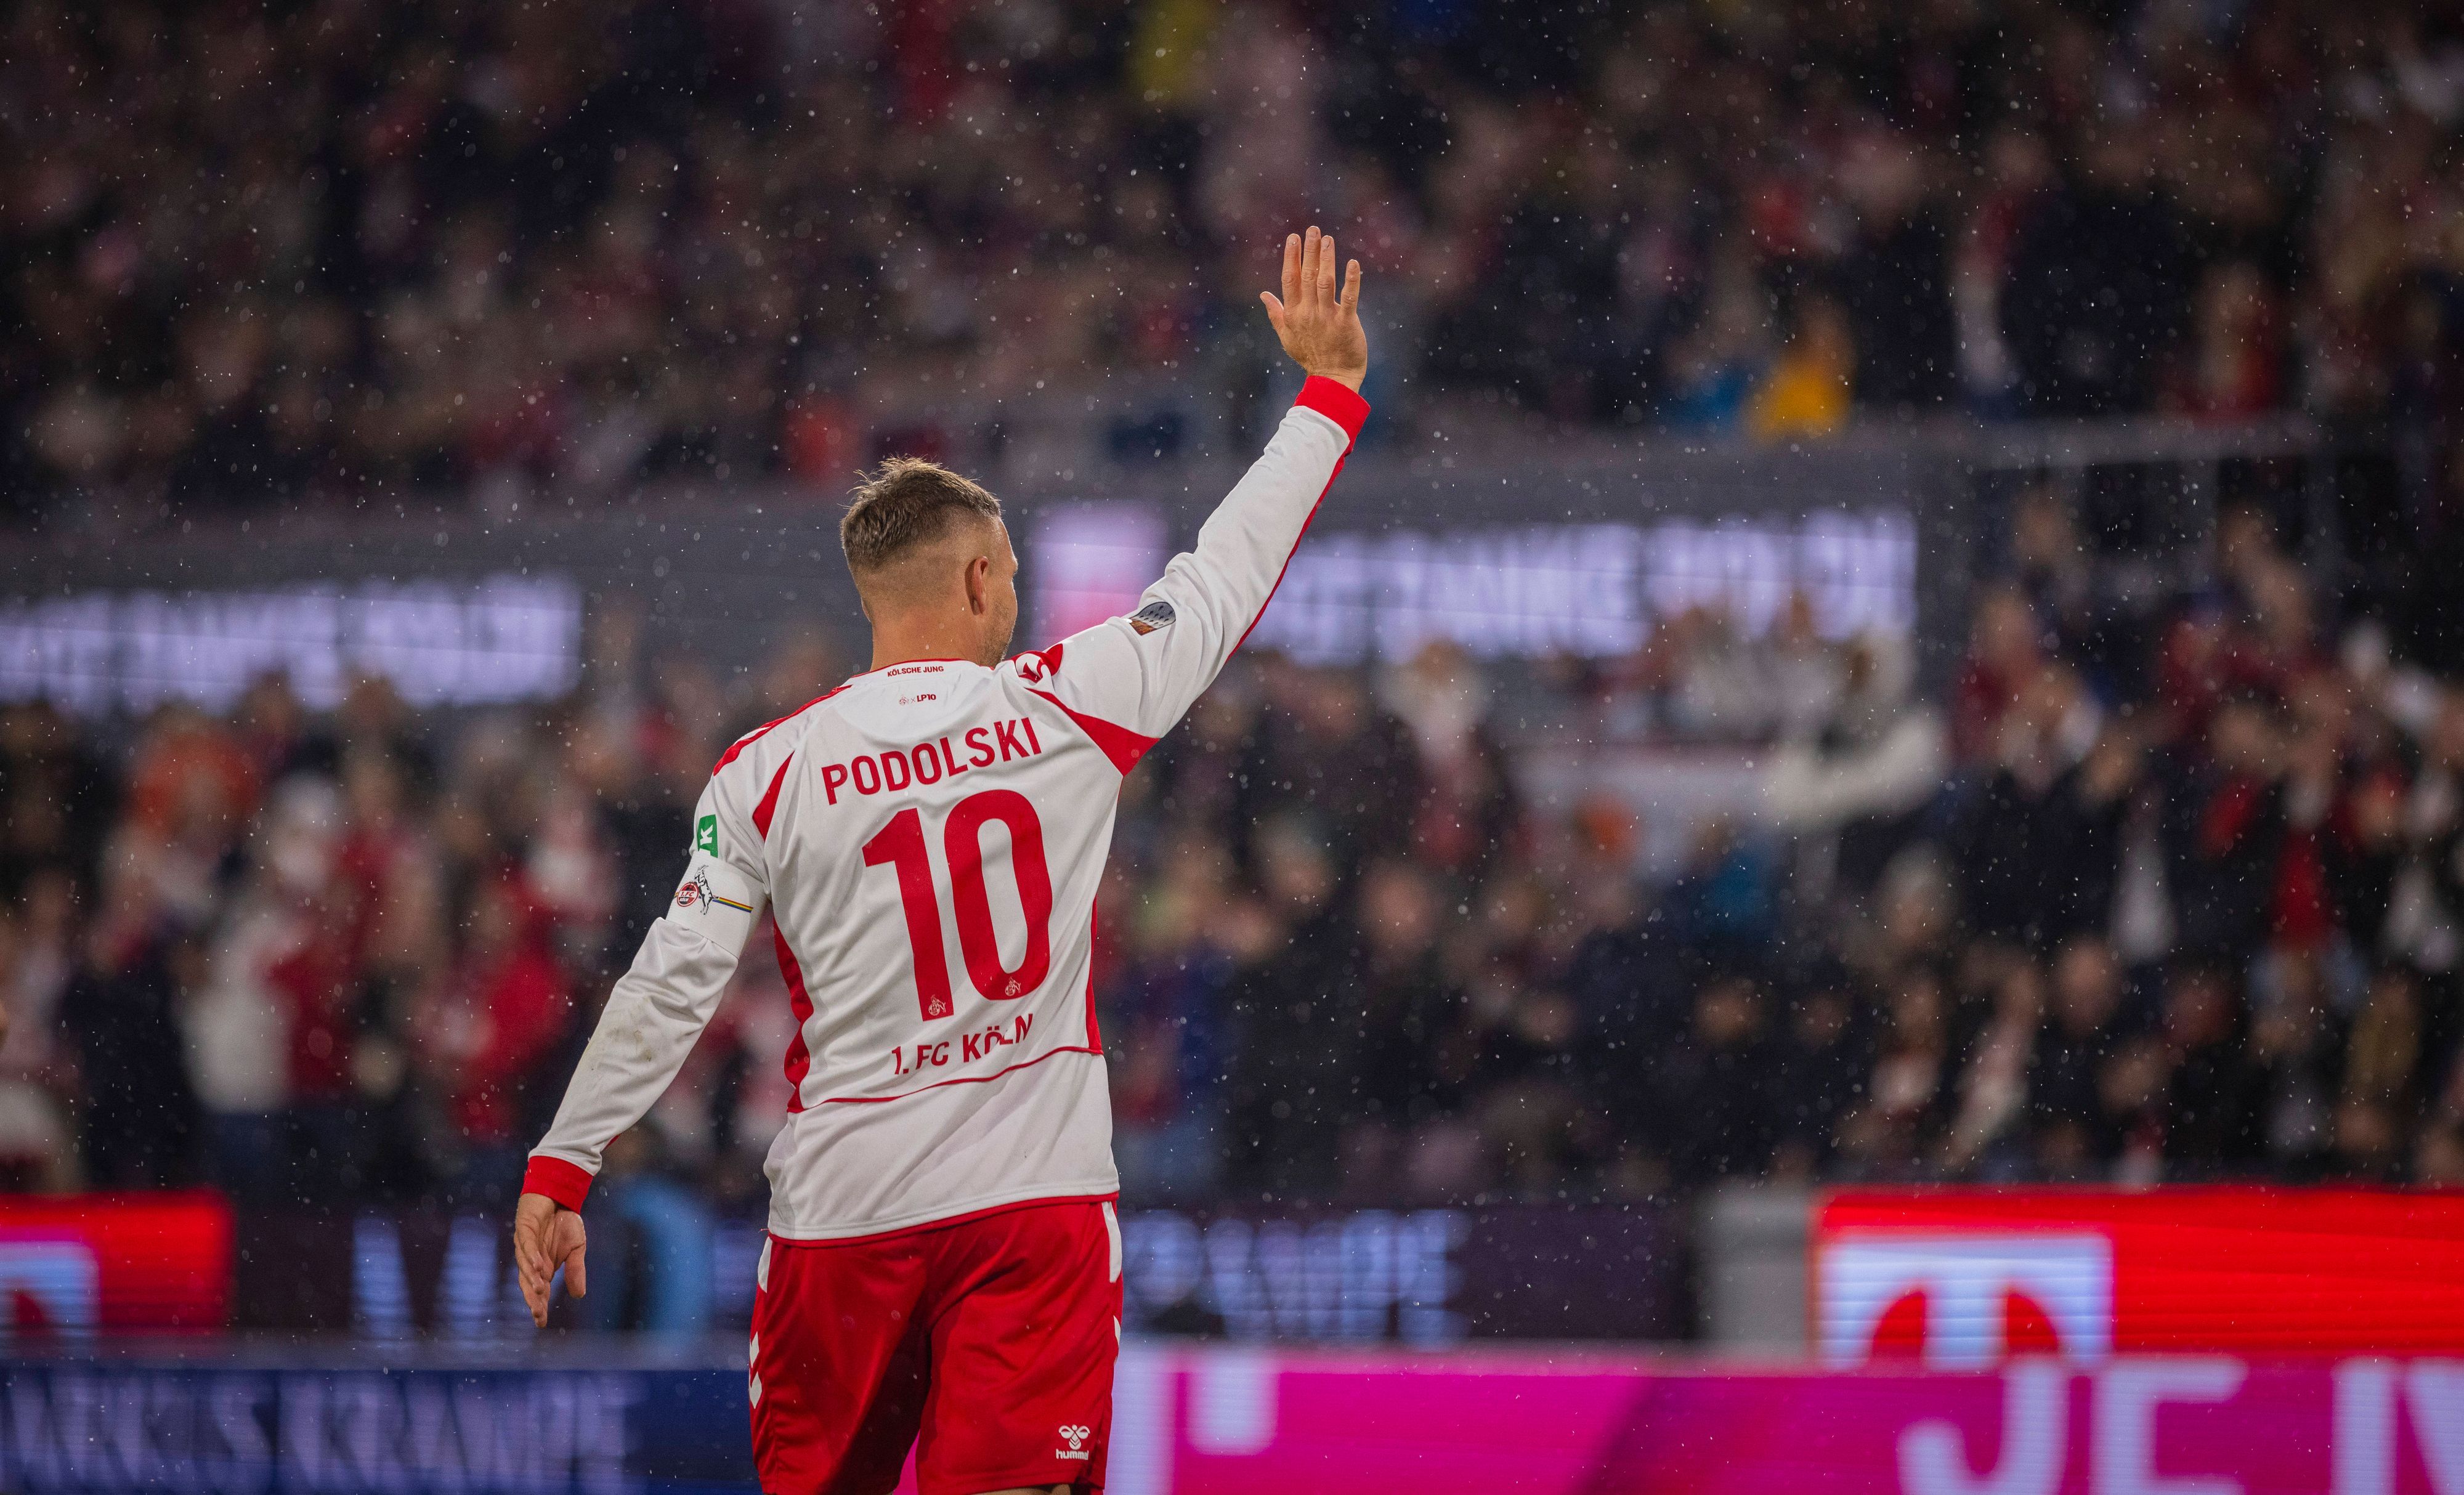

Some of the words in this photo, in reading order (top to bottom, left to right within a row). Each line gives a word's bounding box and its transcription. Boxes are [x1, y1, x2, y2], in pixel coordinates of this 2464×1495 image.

[888, 666, 922, 677] KÖLSCHE
[917, 694, 936, 702] LP10
[821, 717, 1042, 805] PODOLSKI
[862, 789, 1053, 1021] 10
[891, 1045, 909, 1075] 1.
[915, 1041, 950, 1070] FC
